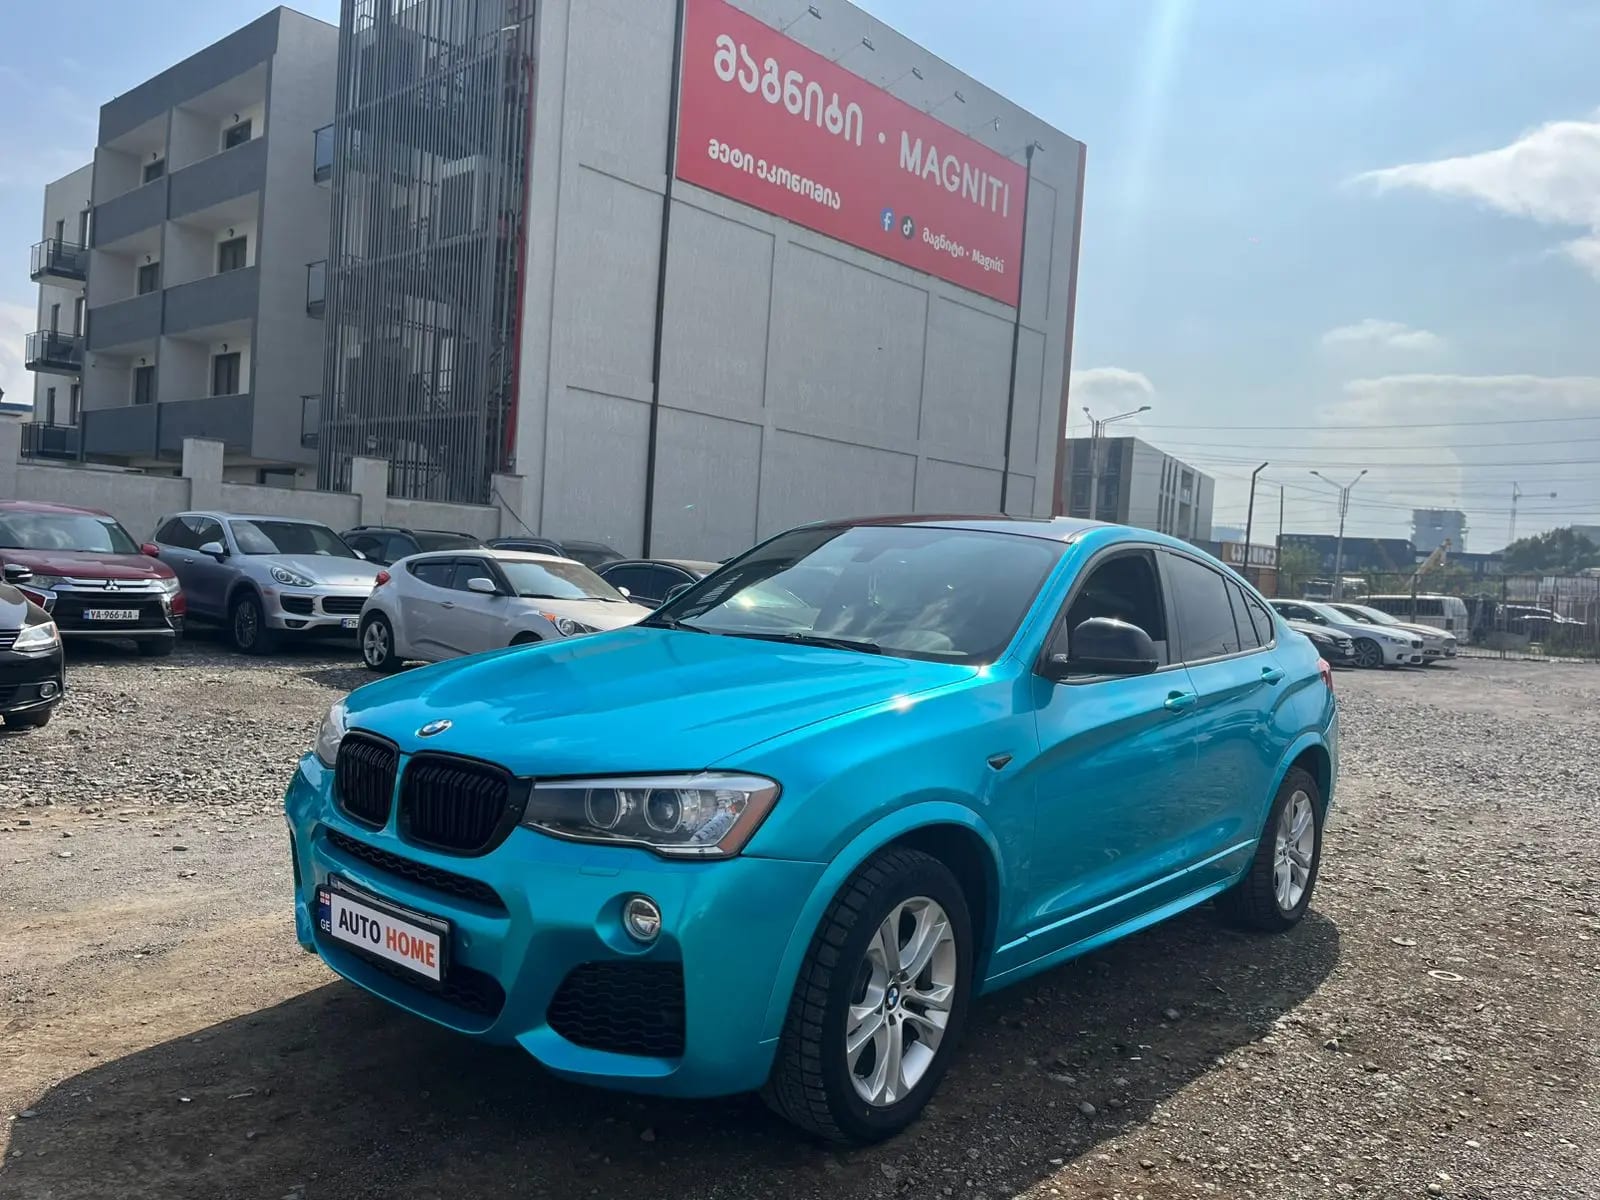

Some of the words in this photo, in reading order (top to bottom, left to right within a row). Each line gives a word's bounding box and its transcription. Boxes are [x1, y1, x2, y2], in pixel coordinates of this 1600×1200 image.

[900, 130, 1010, 218] MAGNITI
[971, 248, 1005, 273] Magniti
[320, 917, 331, 932] GE
[338, 907, 382, 944] AUTO
[386, 925, 436, 968] HOME
